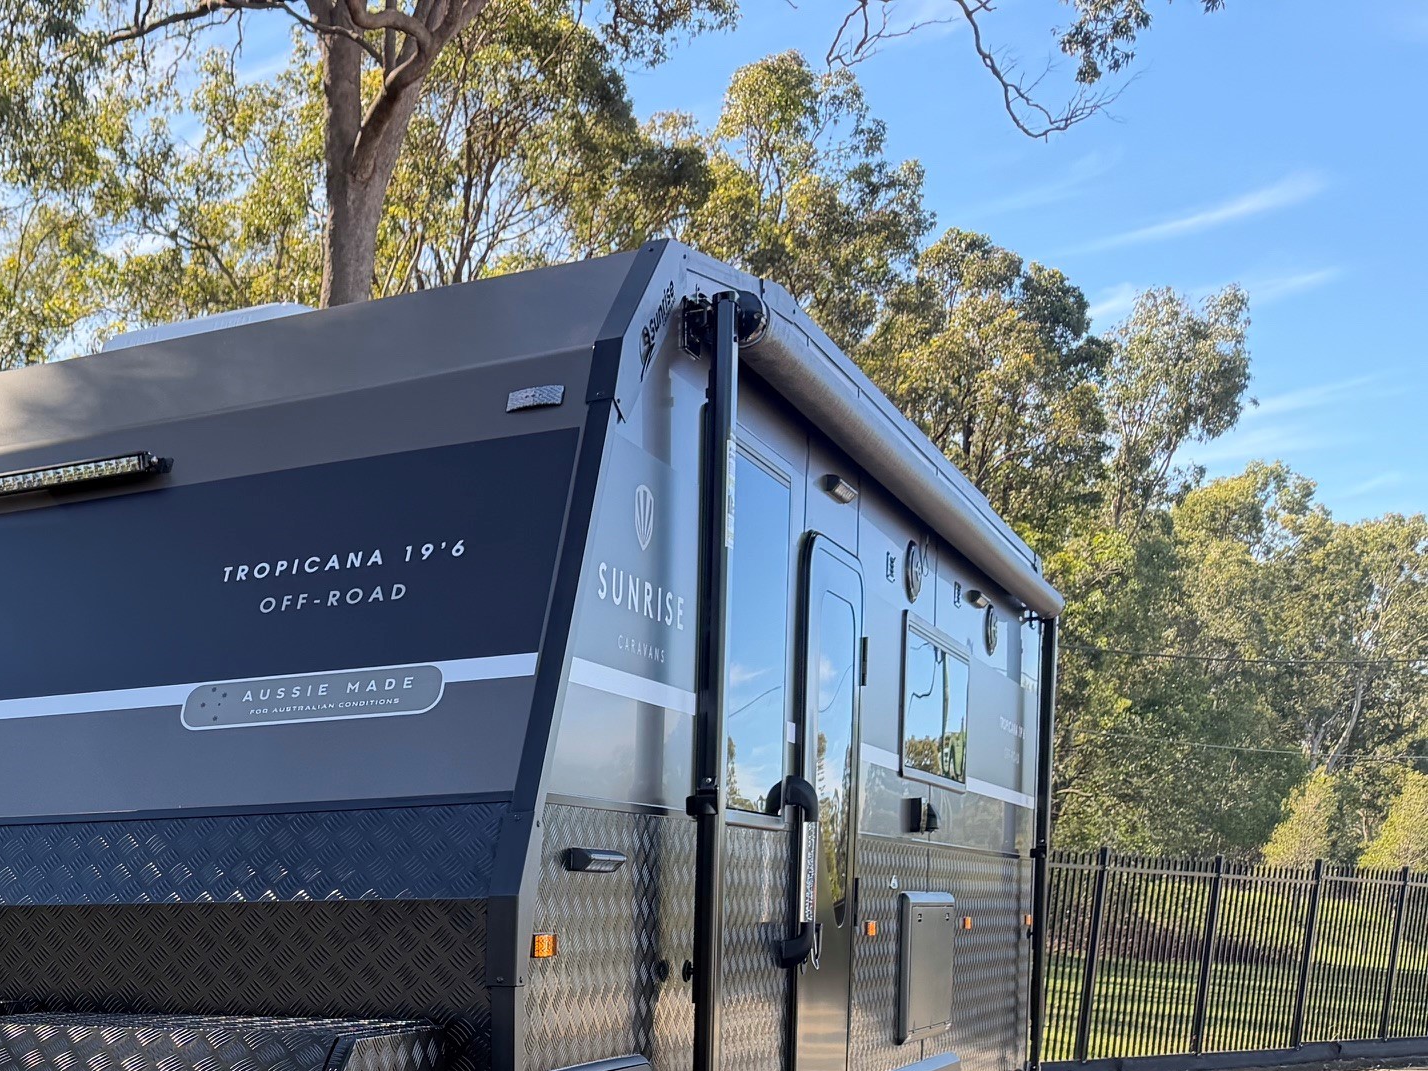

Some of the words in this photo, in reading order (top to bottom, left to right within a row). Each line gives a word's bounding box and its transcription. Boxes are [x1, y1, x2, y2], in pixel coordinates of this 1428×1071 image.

[649, 280, 675, 341] sunrise
[222, 548, 384, 583] TROPICANA
[404, 539, 466, 562] 19'6
[258, 583, 407, 614] OFF-ROAD
[597, 561, 685, 631] SUNRISE
[617, 634, 665, 663] CARAVANS
[241, 683, 329, 702] AUSSIE
[346, 676, 415, 694] MADE
[272, 703, 335, 713] AUSTRALIAN
[338, 697, 401, 708] CONDITIONS
